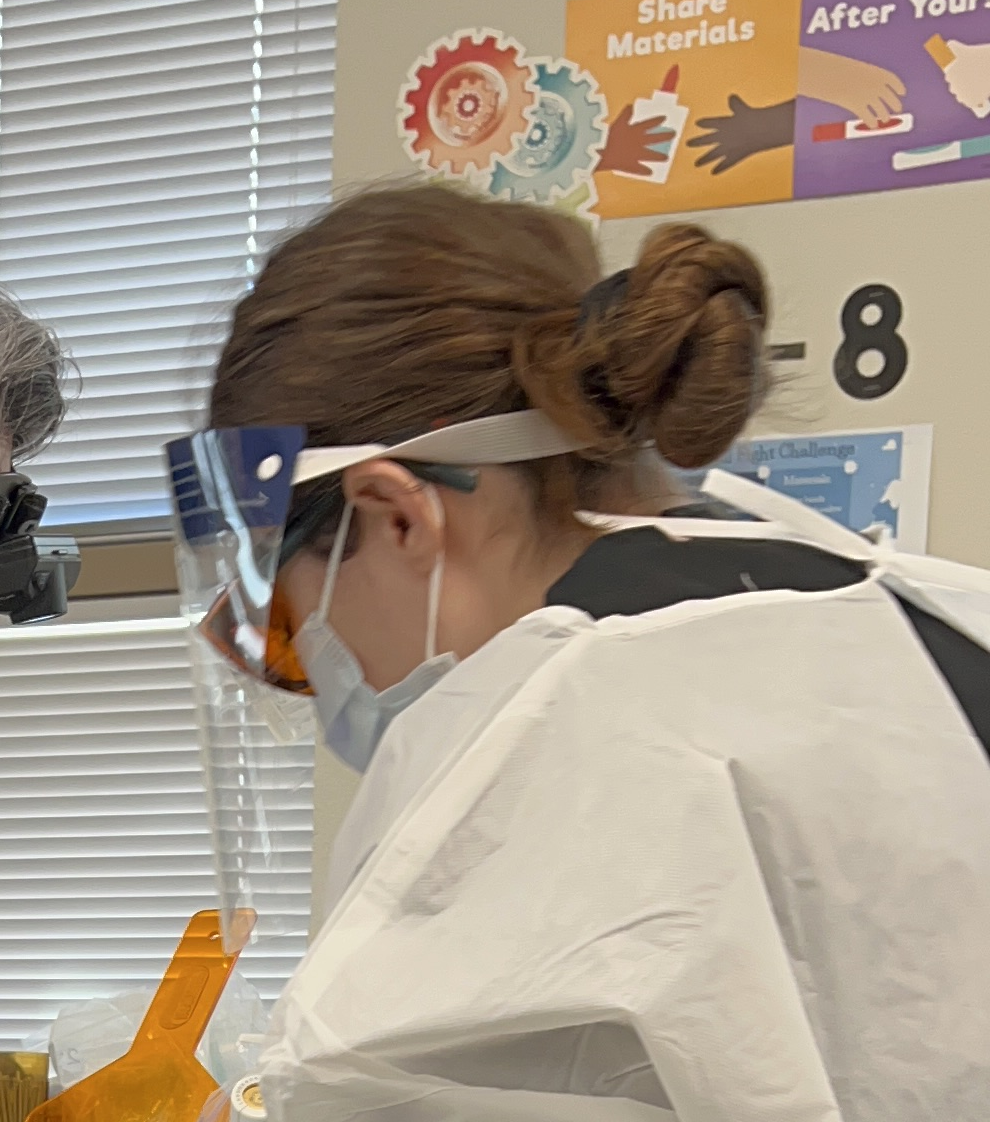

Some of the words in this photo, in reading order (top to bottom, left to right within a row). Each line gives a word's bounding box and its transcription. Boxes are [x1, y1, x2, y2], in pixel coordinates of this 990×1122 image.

[637, 0, 728, 25] Share
[806, 2, 897, 35] After
[909, 0, 990, 19] Your
[607, 17, 756, 60] Materials
[778, 442, 856, 460] Challenge
